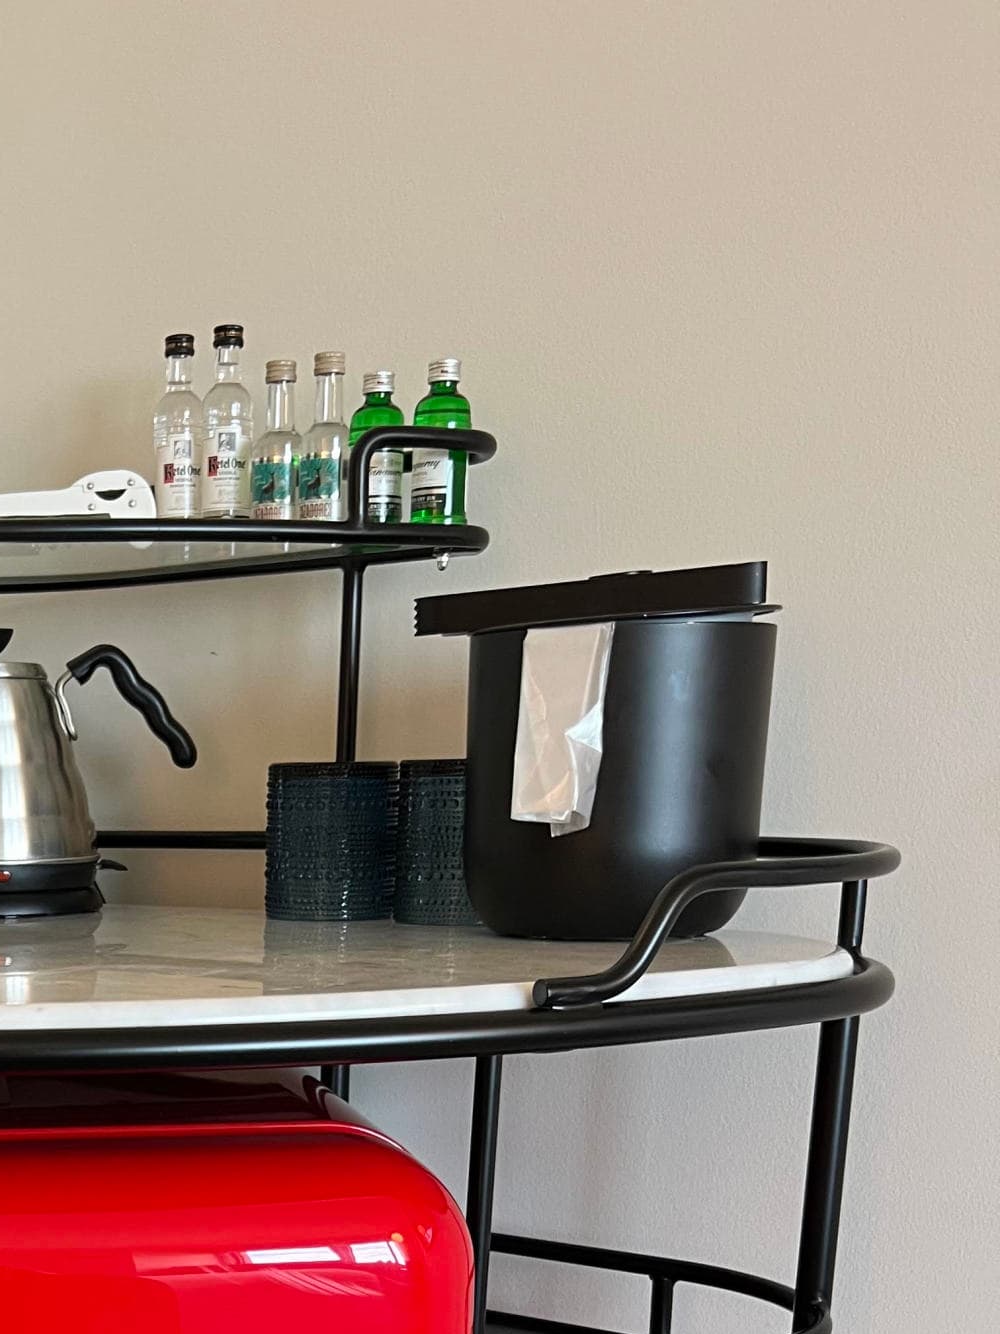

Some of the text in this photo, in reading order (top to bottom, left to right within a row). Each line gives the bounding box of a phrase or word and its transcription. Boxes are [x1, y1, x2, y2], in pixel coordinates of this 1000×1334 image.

[163, 463, 201, 484] Ketel One
[208, 456, 247, 477] Ketel One
